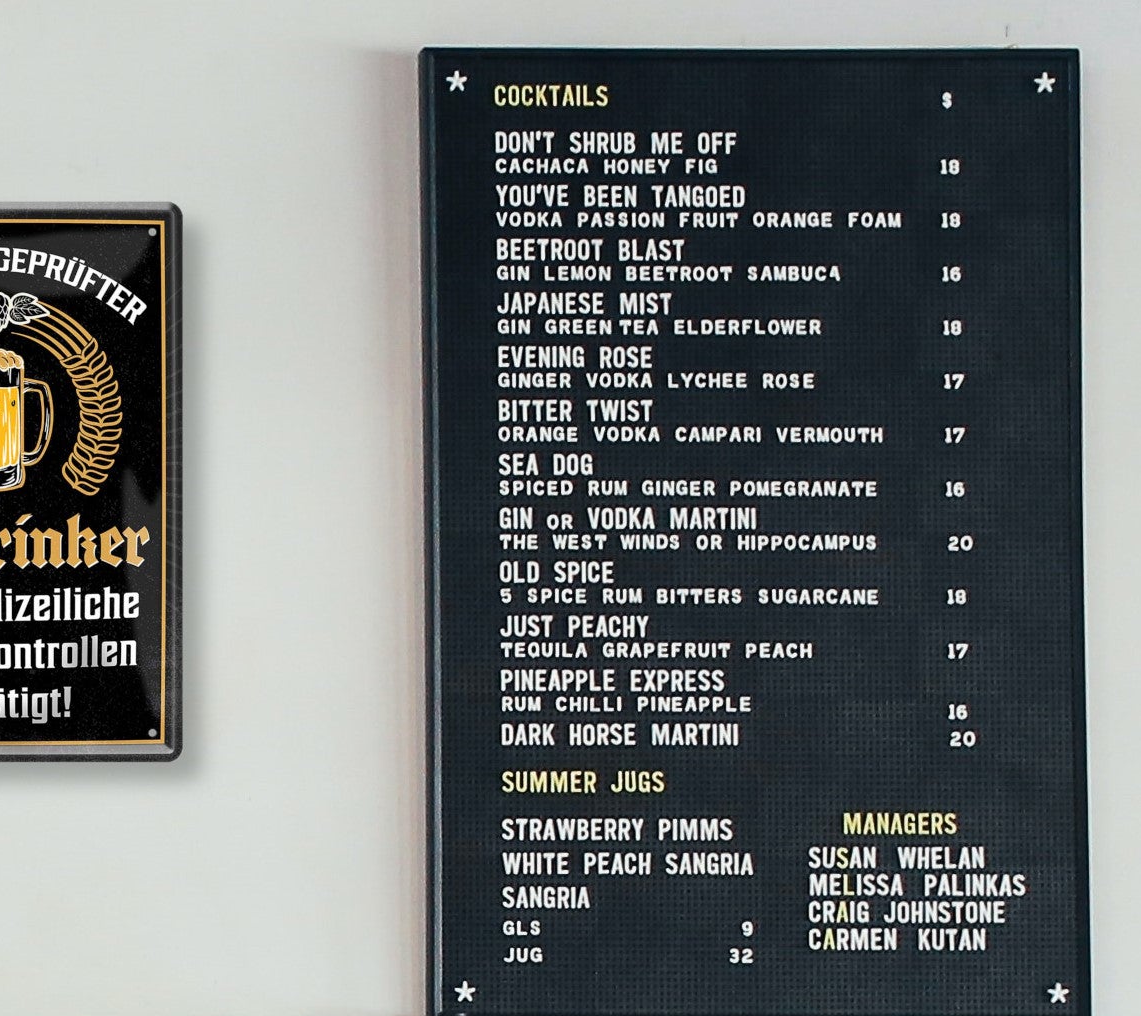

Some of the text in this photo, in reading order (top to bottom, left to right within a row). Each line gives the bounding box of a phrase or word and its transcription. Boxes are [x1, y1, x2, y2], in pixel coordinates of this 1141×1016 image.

[494, 84, 609, 107] COCKTAILS
[494, 130, 737, 155] DON'T SHRUB ME OFF
[495, 157, 960, 176] CACHACA HONEY FIG 18
[495, 183, 746, 209] YOU'VE BEEN TANGOED
[495, 211, 961, 229] VODKA PASSION FRUIT ORANGE FOAM 18
[496, 238, 685, 262] BEETROOT BLAST
[496, 264, 530, 282] GIN
[544, 265, 612, 282] LEMON
[625, 265, 733, 282] BEETROOT
[941, 265, 962, 283] 16
[496, 291, 673, 316] JAPANESE MIST
[497, 318, 962, 336] GIN GREEN TEA ELDERFLOWER 18
[497, 345, 653, 370] EVENING ROSE
[497, 372, 965, 390] GINGER VODKA LYCHEE ROSE 17
[498, 399, 654, 423] BITTER TWIST
[497, 425, 966, 444] ORANGE VODKA CAMPARI VERMOUTH 17
[498, 452, 594, 477] SEA DOG
[499, 479, 965, 498] SPICED RUM GINGER POMEGRANATE 16
[499, 506, 757, 531] GIN OR VODKA MARTINI
[499, 533, 974, 552] THE WEST WINDS OR HIPPOCAMPUS 20
[499, 560, 615, 584] OLD SPICE
[499, 587, 967, 606] 5 SPICE RUM BITTERS SUGARCANE 18
[499, 614, 649, 639] JUST PEACHY
[500, 641, 969, 660] TEQUILA GRAPEFRUIT PEACH 17
[500, 668, 725, 693] PINEAPPLE EXPRESS
[501, 695, 752, 713] RUM CHILLI PINEAPPLE
[947, 703, 968, 721] 16
[501, 722, 739, 747] DARK HORSE MARTINI
[949, 730, 977, 748] 20
[501, 770, 665, 794] SUMMER JUGS
[501, 817, 734, 842] STRAWBERRY PIMMS
[843, 812, 958, 836] MANAGERS
[502, 851, 754, 876] WHITE PEACH SANGRIA
[808, 845, 985, 870] SUSAN WHELAN
[809, 872, 1027, 898] MELISSA PALINKAS
[502, 885, 591, 910] SANGRIA
[808, 900, 1006, 925] CRAIG JOHNSTONE
[502, 920, 541, 936] GLS
[741, 920, 754, 937] 9
[808, 927, 987, 952] CARMEN KUTAN
[503, 946, 543, 964] JUG
[729, 947, 754, 964] 32
